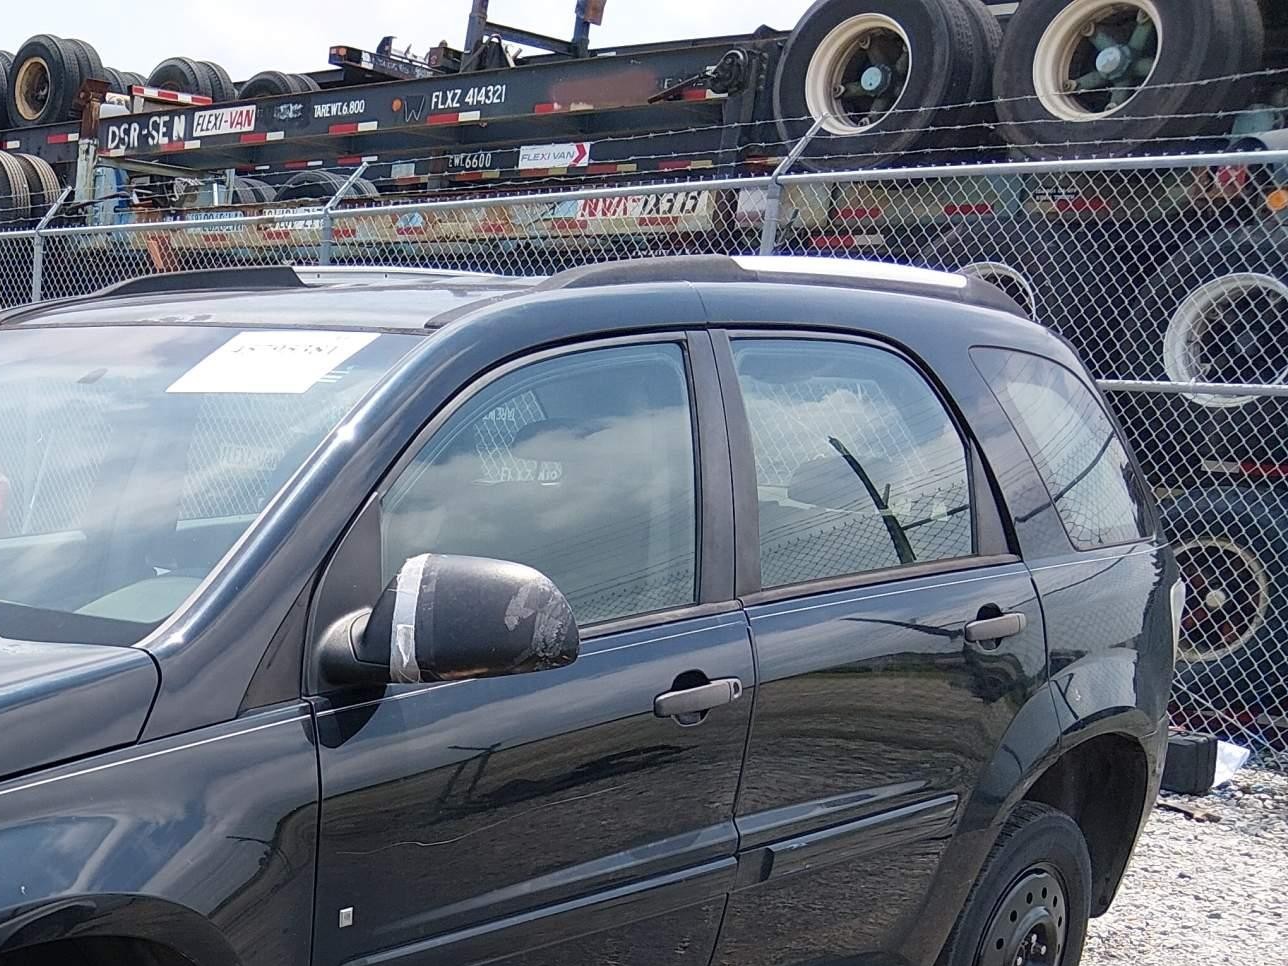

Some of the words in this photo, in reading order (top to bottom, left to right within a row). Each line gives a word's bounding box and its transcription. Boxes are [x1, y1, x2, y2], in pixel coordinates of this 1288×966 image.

[432, 89, 462, 110] FLXZ
[464, 84, 506, 106] 414321
[195, 109, 254, 132] FLEXI-VAN
[521, 152, 551, 162] FLEXI
[552, 150, 575, 160] VAN
